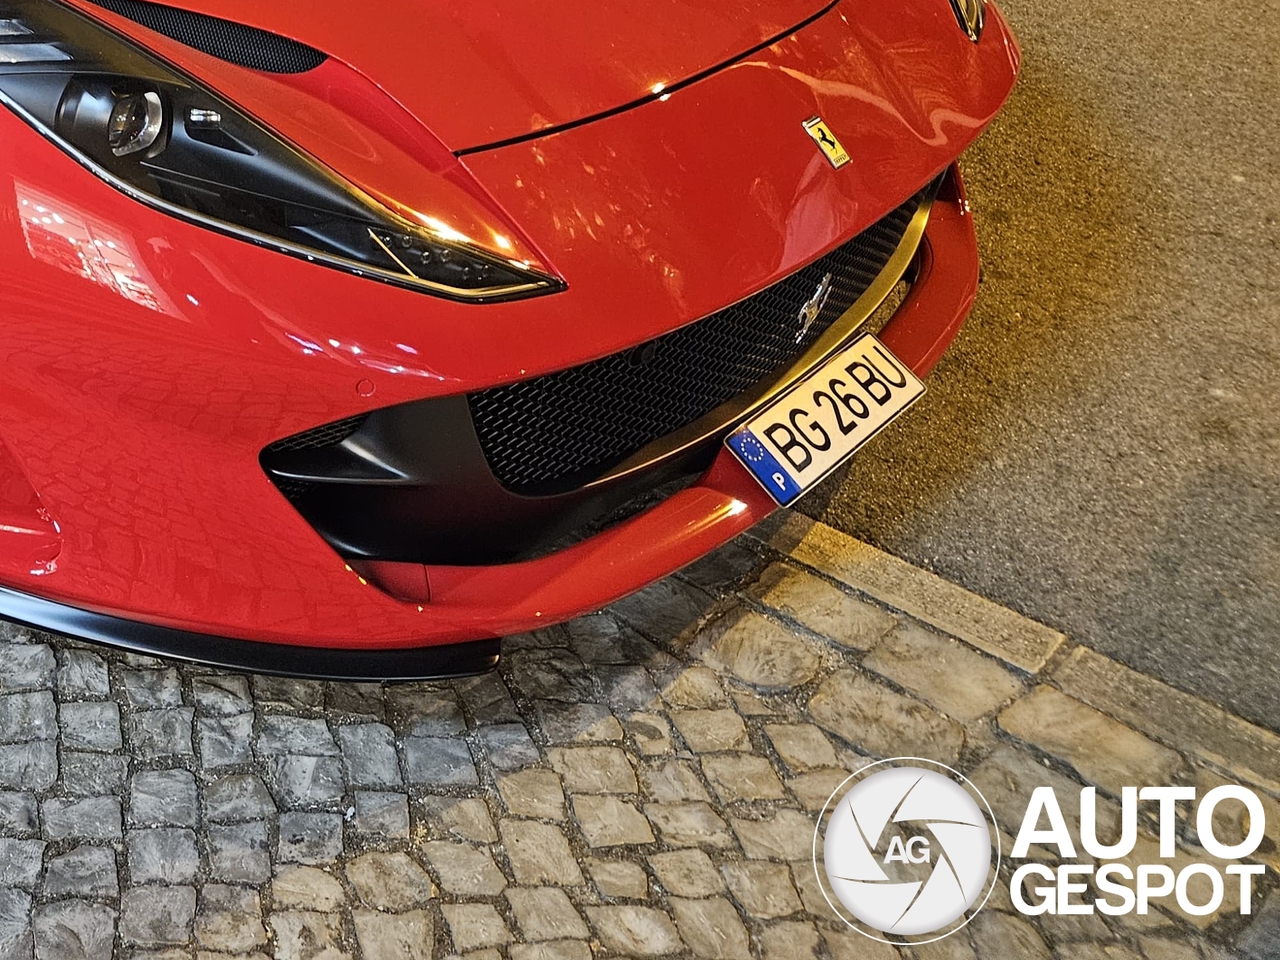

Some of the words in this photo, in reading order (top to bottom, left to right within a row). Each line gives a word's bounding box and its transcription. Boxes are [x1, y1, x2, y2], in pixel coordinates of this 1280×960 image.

[763, 408, 831, 473] BG
[813, 378, 870, 436] 26
[844, 345, 907, 406] BU
[772, 472, 786, 491] P
